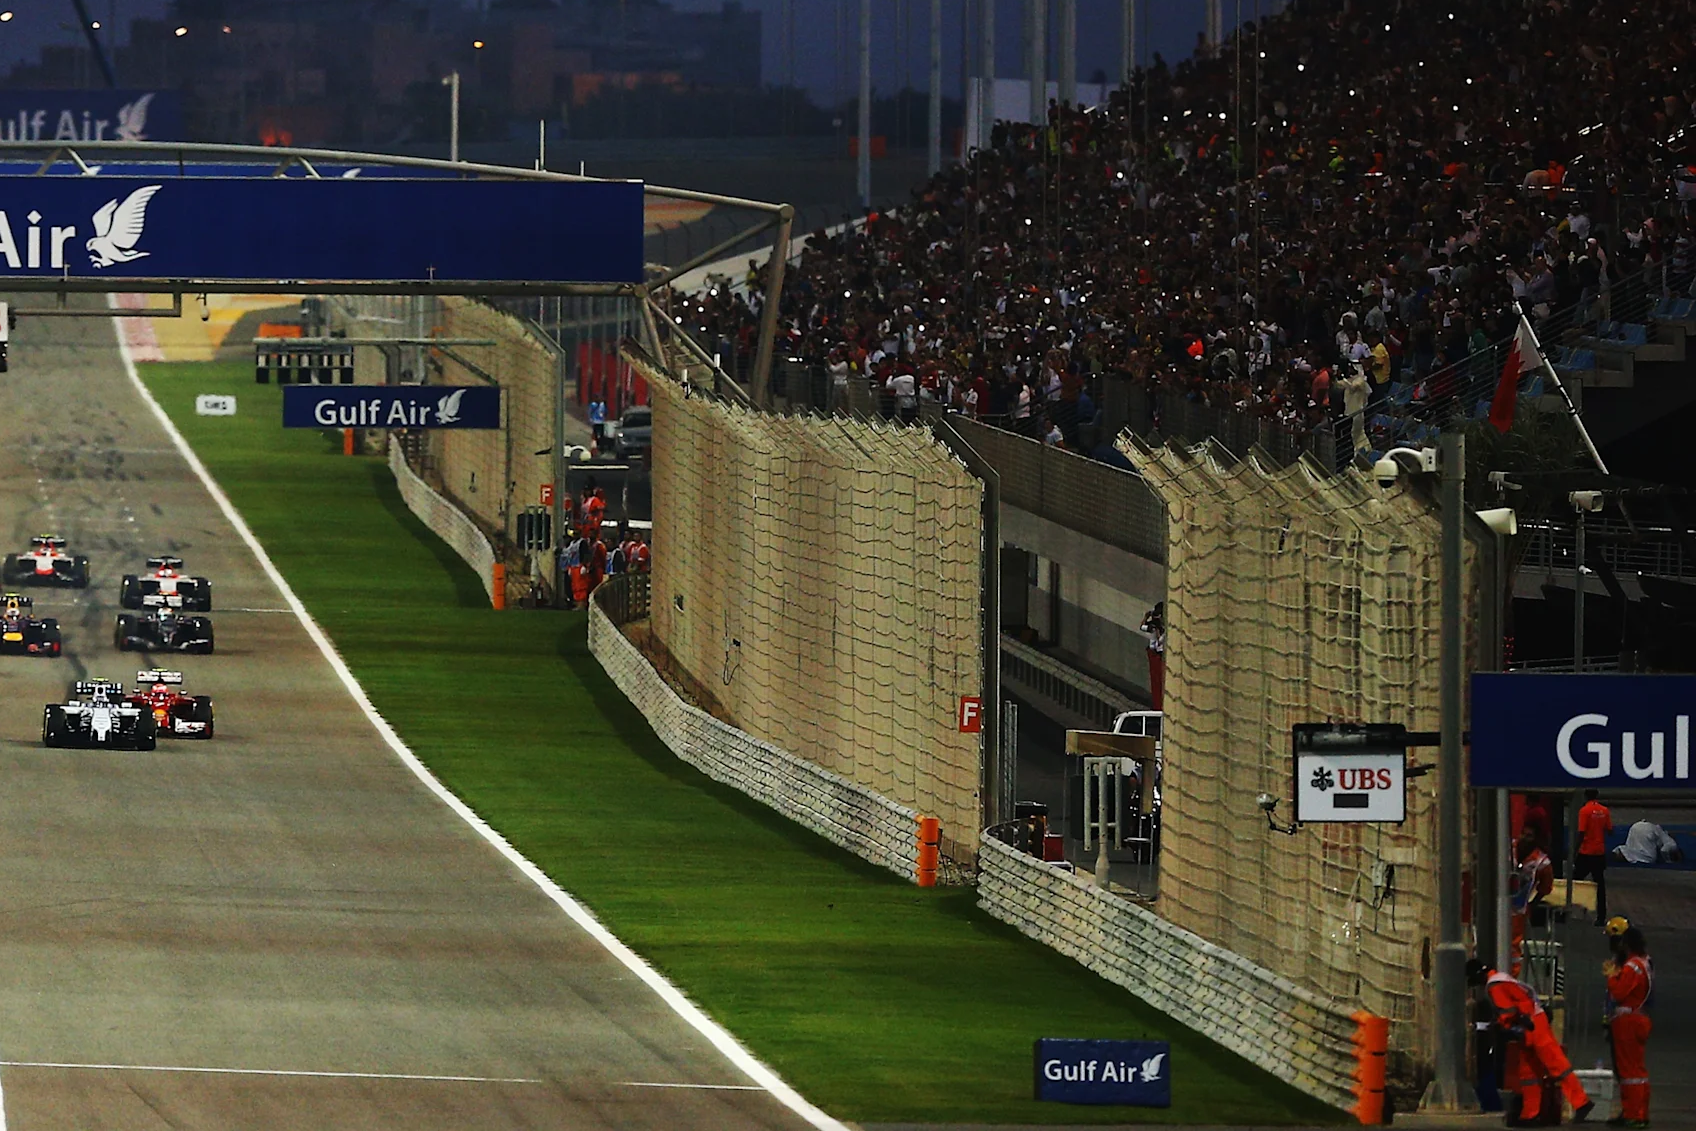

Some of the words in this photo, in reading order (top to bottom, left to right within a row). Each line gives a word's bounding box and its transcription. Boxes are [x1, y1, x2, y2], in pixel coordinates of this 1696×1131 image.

[55, 109, 108, 142] Air
[314, 399, 382, 426] Gulf
[386, 399, 431, 426] Air
[542, 487, 551, 502] F
[963, 702, 979, 726] F
[1337, 768, 1392, 791] UBS
[1044, 1059, 1099, 1082] Gulf
[1101, 1061, 1138, 1083] Air
